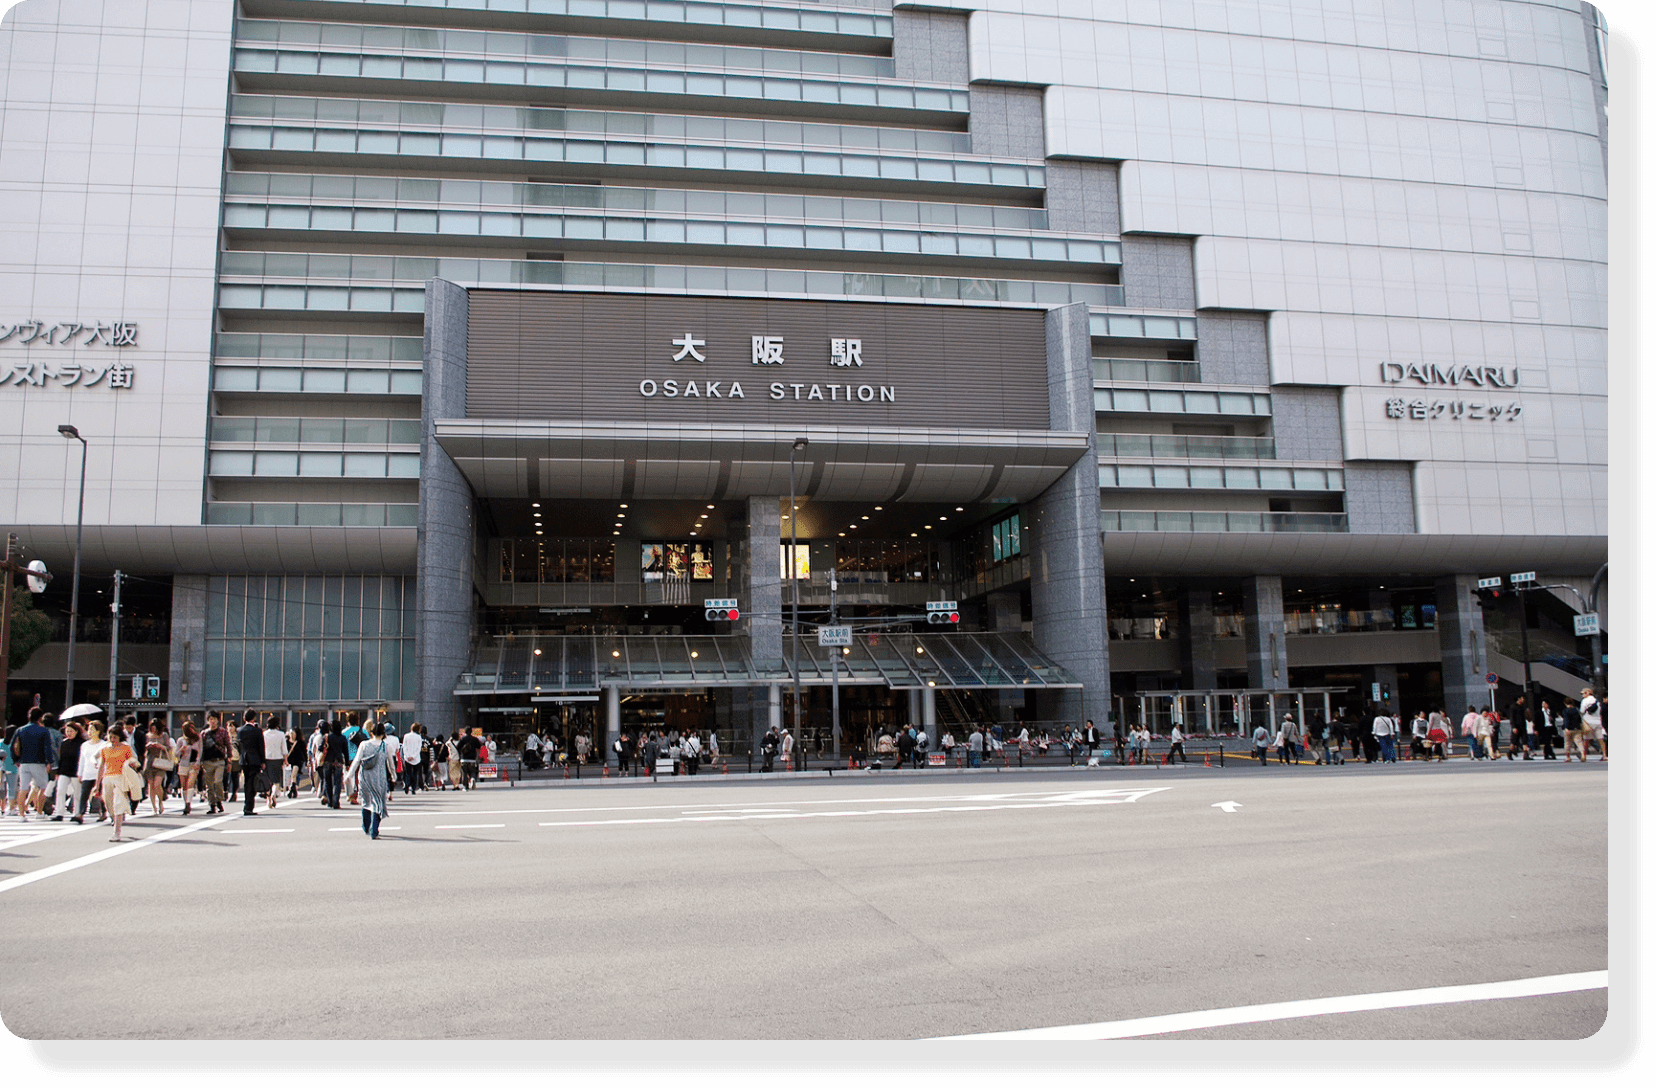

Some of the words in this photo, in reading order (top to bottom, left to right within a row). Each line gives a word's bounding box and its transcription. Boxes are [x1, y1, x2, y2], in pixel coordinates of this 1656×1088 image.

[672, 333, 863, 367] 大阪駅
[1380, 361, 1519, 388] DAIMARU
[639, 379, 745, 398] OSAKA
[769, 382, 895, 402] STATION
[1385, 398, 1522, 422] 総合クリニック
